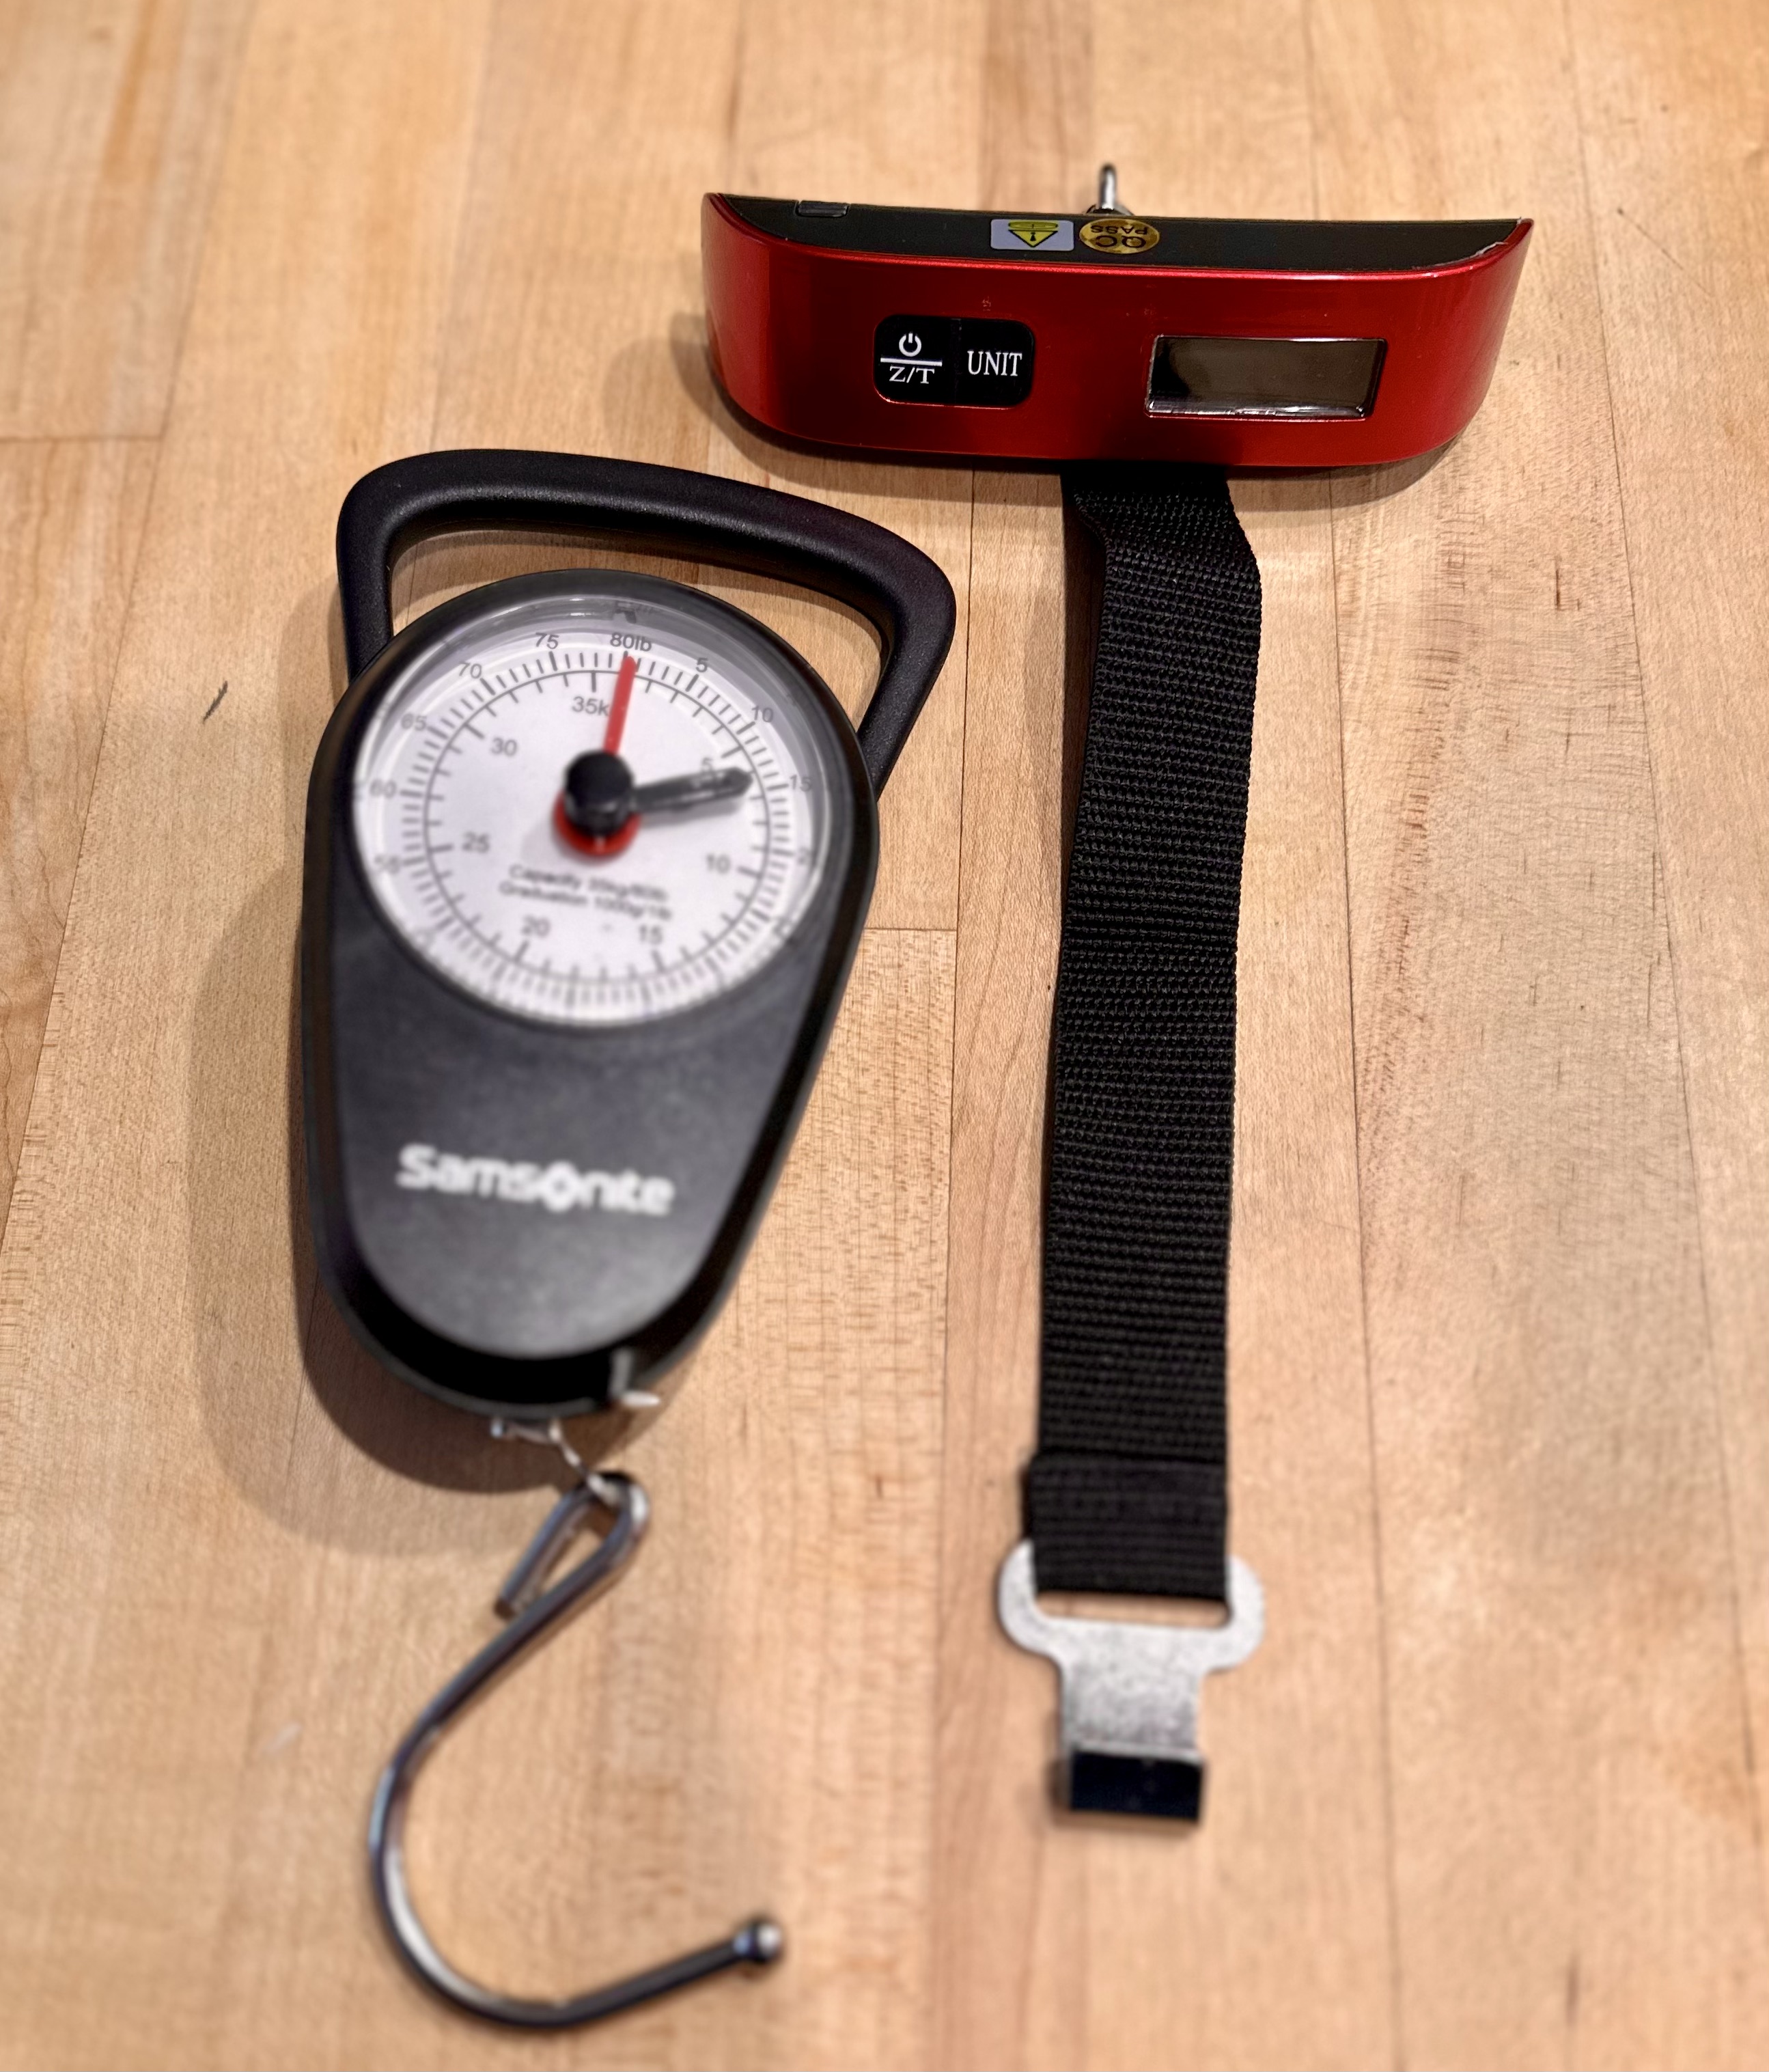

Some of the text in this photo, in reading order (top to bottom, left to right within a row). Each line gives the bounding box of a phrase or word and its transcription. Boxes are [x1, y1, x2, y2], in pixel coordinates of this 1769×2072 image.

[1090, 225, 1148, 235] PASS
[1096, 234, 1147, 248] QC
[967, 350, 1022, 376] UNIT
[889, 365, 935, 384] Z/T
[535, 632, 559, 649] 75
[610, 632, 652, 652] 80lb
[458, 661, 482, 679] 70
[695, 657, 709, 673] 5
[571, 695, 609, 717] 35k
[751, 705, 774, 723] 10
[400, 713, 427, 731] 65
[490, 737, 518, 756] 30
[370, 780, 398, 799] 60
[790, 774, 813, 792] 15
[461, 831, 490, 853] 25
[706, 854, 732, 875] 10
[521, 915, 551, 939] 20
[639, 924, 663, 945] 15
[395, 1143, 675, 1217] Samsonite
